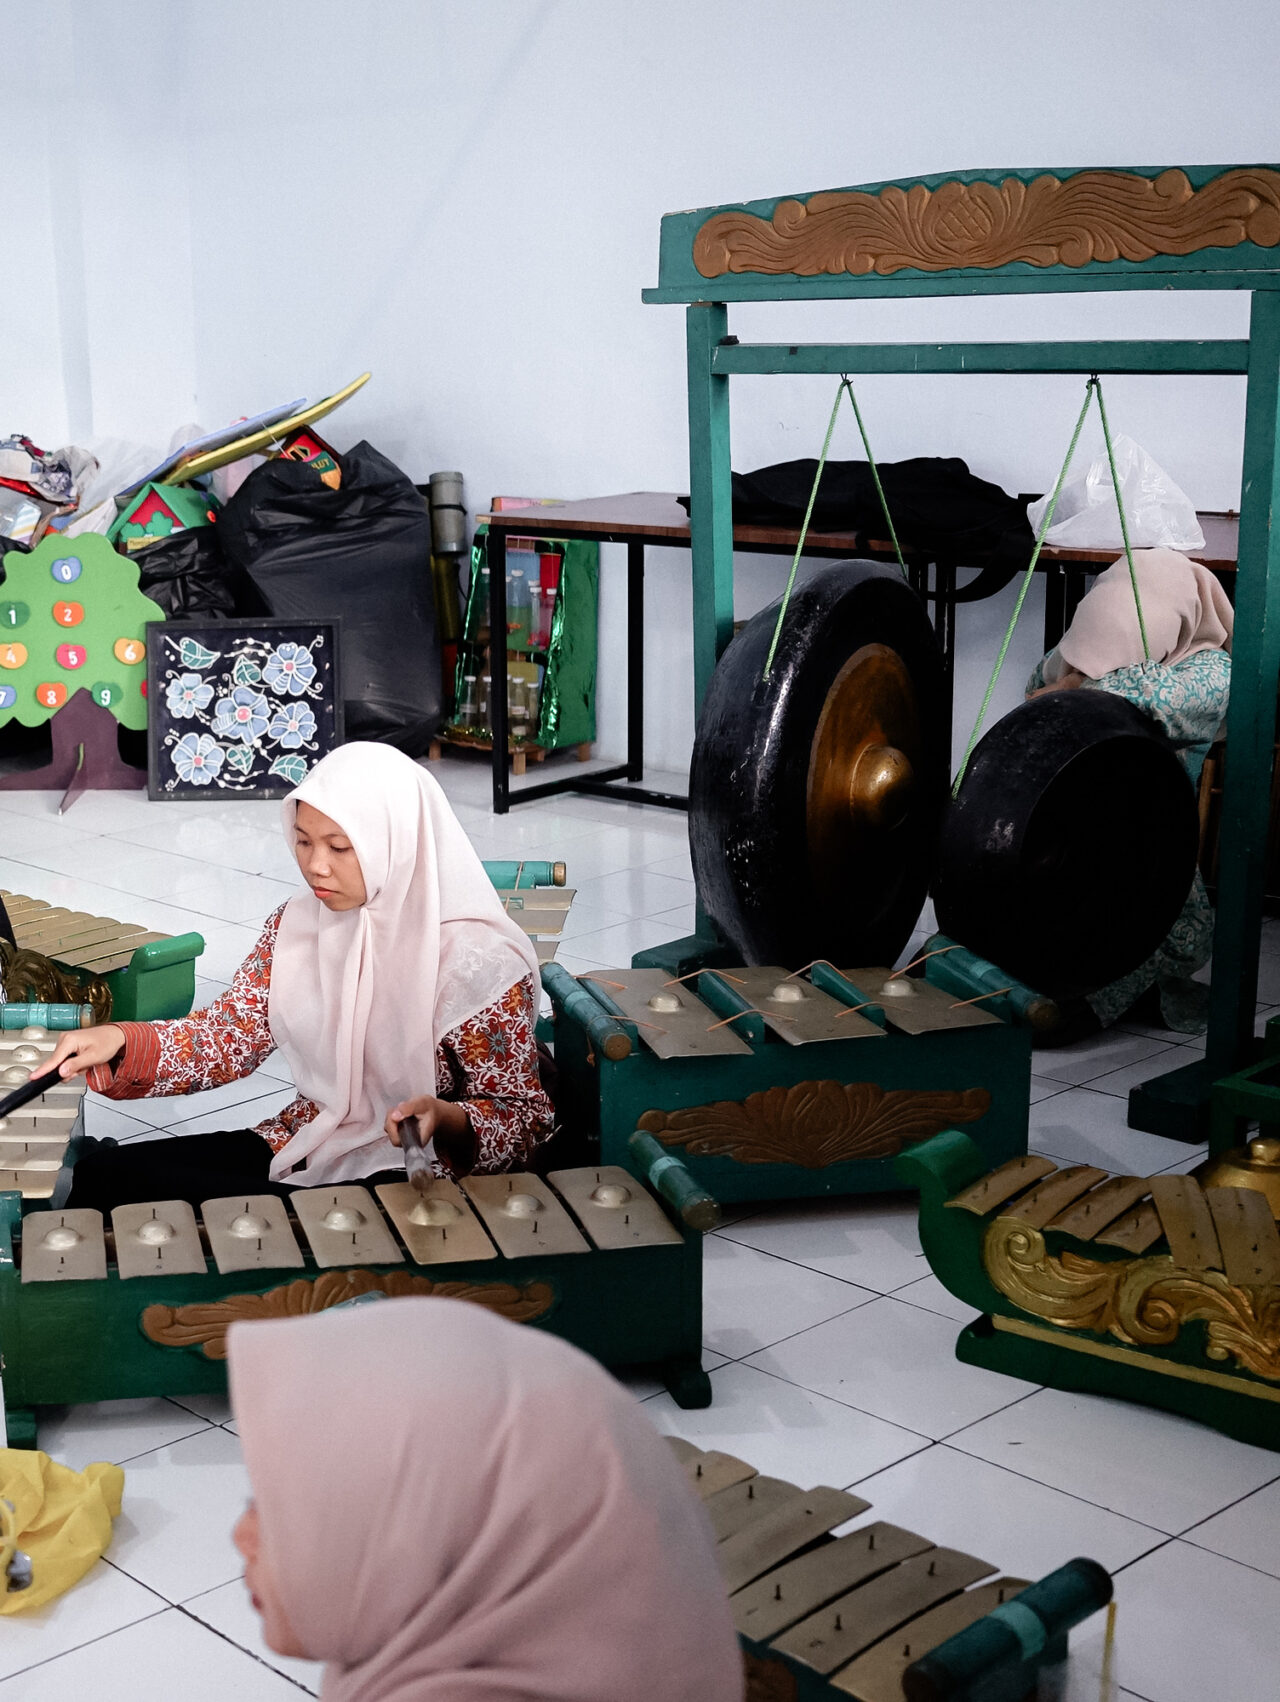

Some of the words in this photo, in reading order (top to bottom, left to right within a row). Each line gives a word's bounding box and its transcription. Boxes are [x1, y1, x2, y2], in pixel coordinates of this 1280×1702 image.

[61, 565, 72, 580] 0
[8, 609, 17, 625] 1
[63, 608, 73, 622] 2
[5, 649, 17, 663] 4
[68, 651, 78, 665] 5
[124, 644, 137, 661] 6
[47, 690, 57, 705] 8
[100, 689, 111, 705] 9
